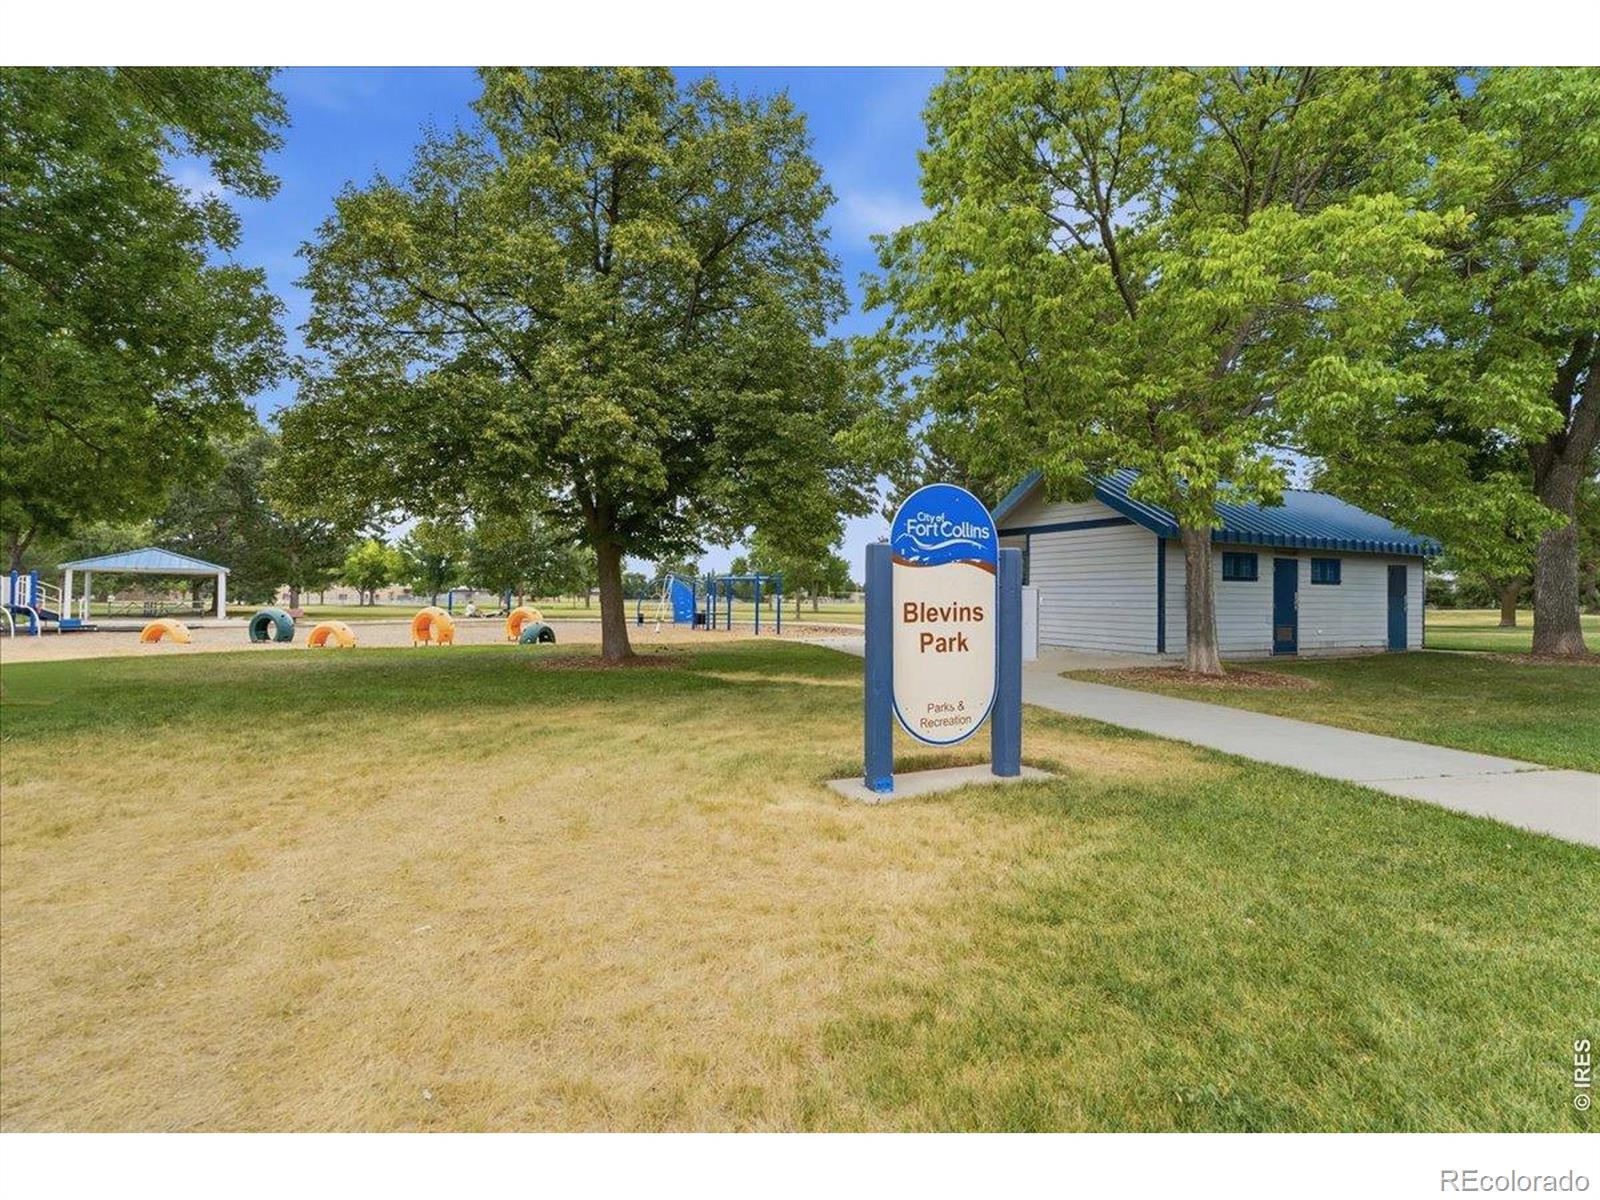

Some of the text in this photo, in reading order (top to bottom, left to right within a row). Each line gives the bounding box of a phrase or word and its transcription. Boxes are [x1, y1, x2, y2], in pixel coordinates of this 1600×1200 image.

[917, 511, 945, 524] City of
[906, 519, 990, 539] Fort Collins
[903, 602, 984, 623] Blevins
[920, 632, 969, 653] Park
[927, 700, 965, 714] Parks &
[919, 715, 972, 729] Recreation
